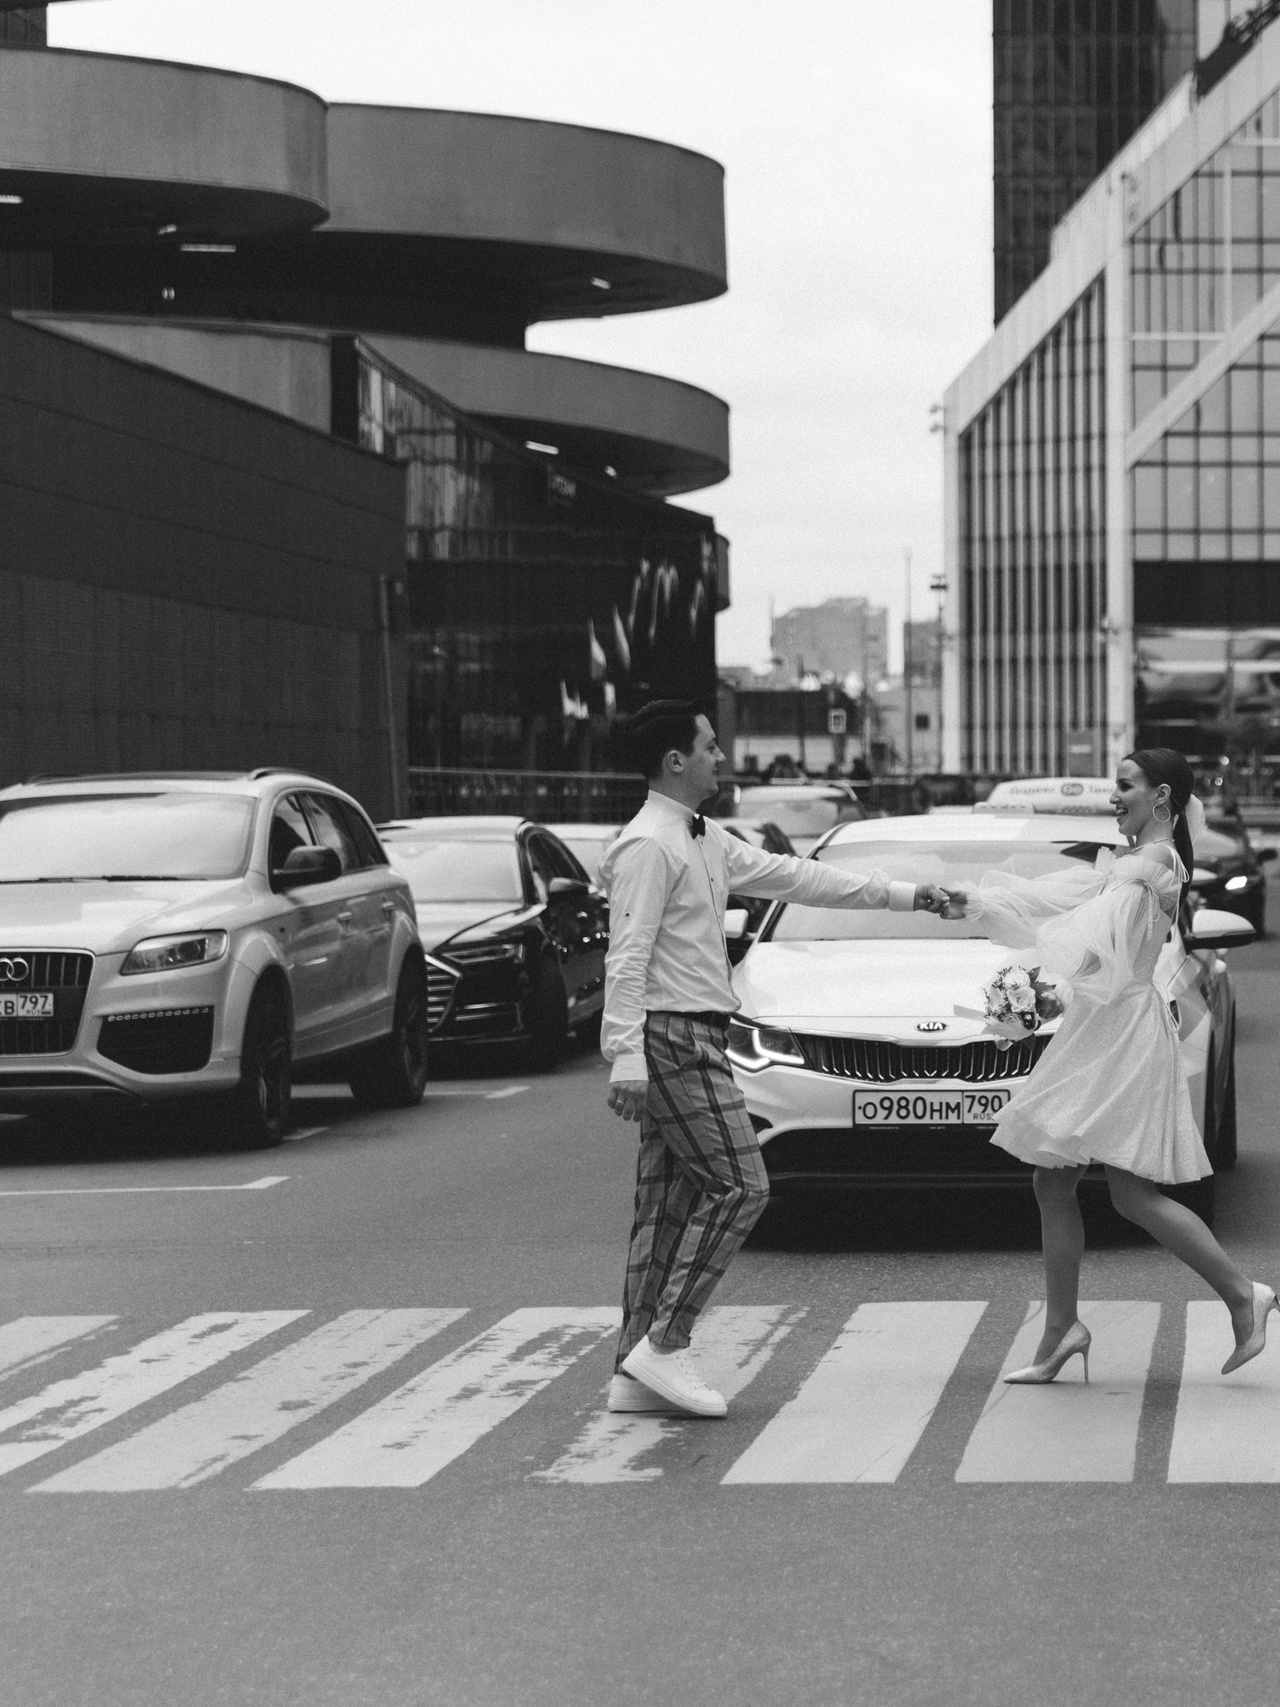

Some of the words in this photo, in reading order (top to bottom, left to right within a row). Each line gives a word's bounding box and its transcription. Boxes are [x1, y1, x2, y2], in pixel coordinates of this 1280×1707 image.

[19, 995, 49, 1010] 797
[920, 1021, 944, 1030] KIA
[964, 1094, 1003, 1114] 790
[972, 1113, 992, 1121] RUS
